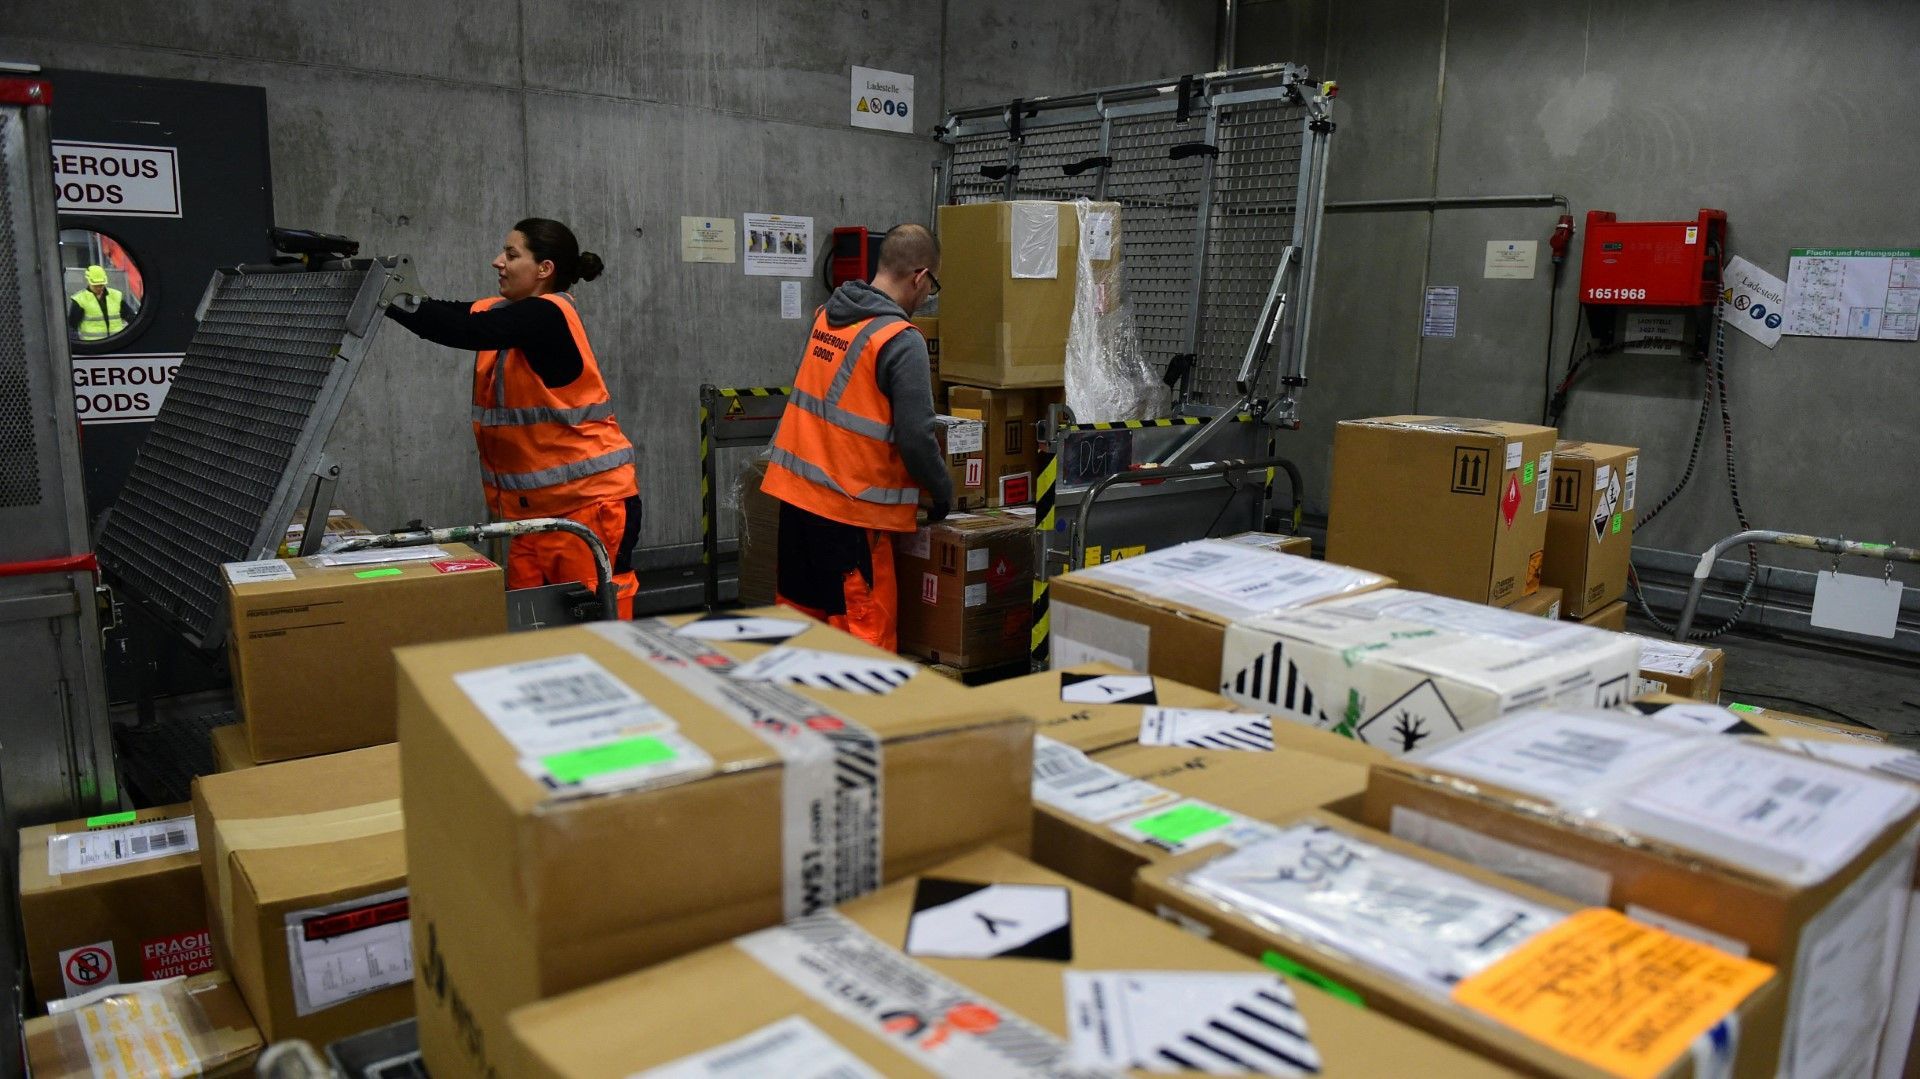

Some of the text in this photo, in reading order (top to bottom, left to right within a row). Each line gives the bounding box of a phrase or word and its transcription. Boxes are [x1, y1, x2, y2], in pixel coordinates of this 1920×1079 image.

[866, 80, 899, 93] Ladestelle
[1588, 288, 1646, 299] 1651968
[1742, 276, 1783, 305] Ladestelle
[812, 329, 849, 352] DANGEROUS
[813, 345, 835, 363] GOODS
[152, 964, 185, 981] WITH
